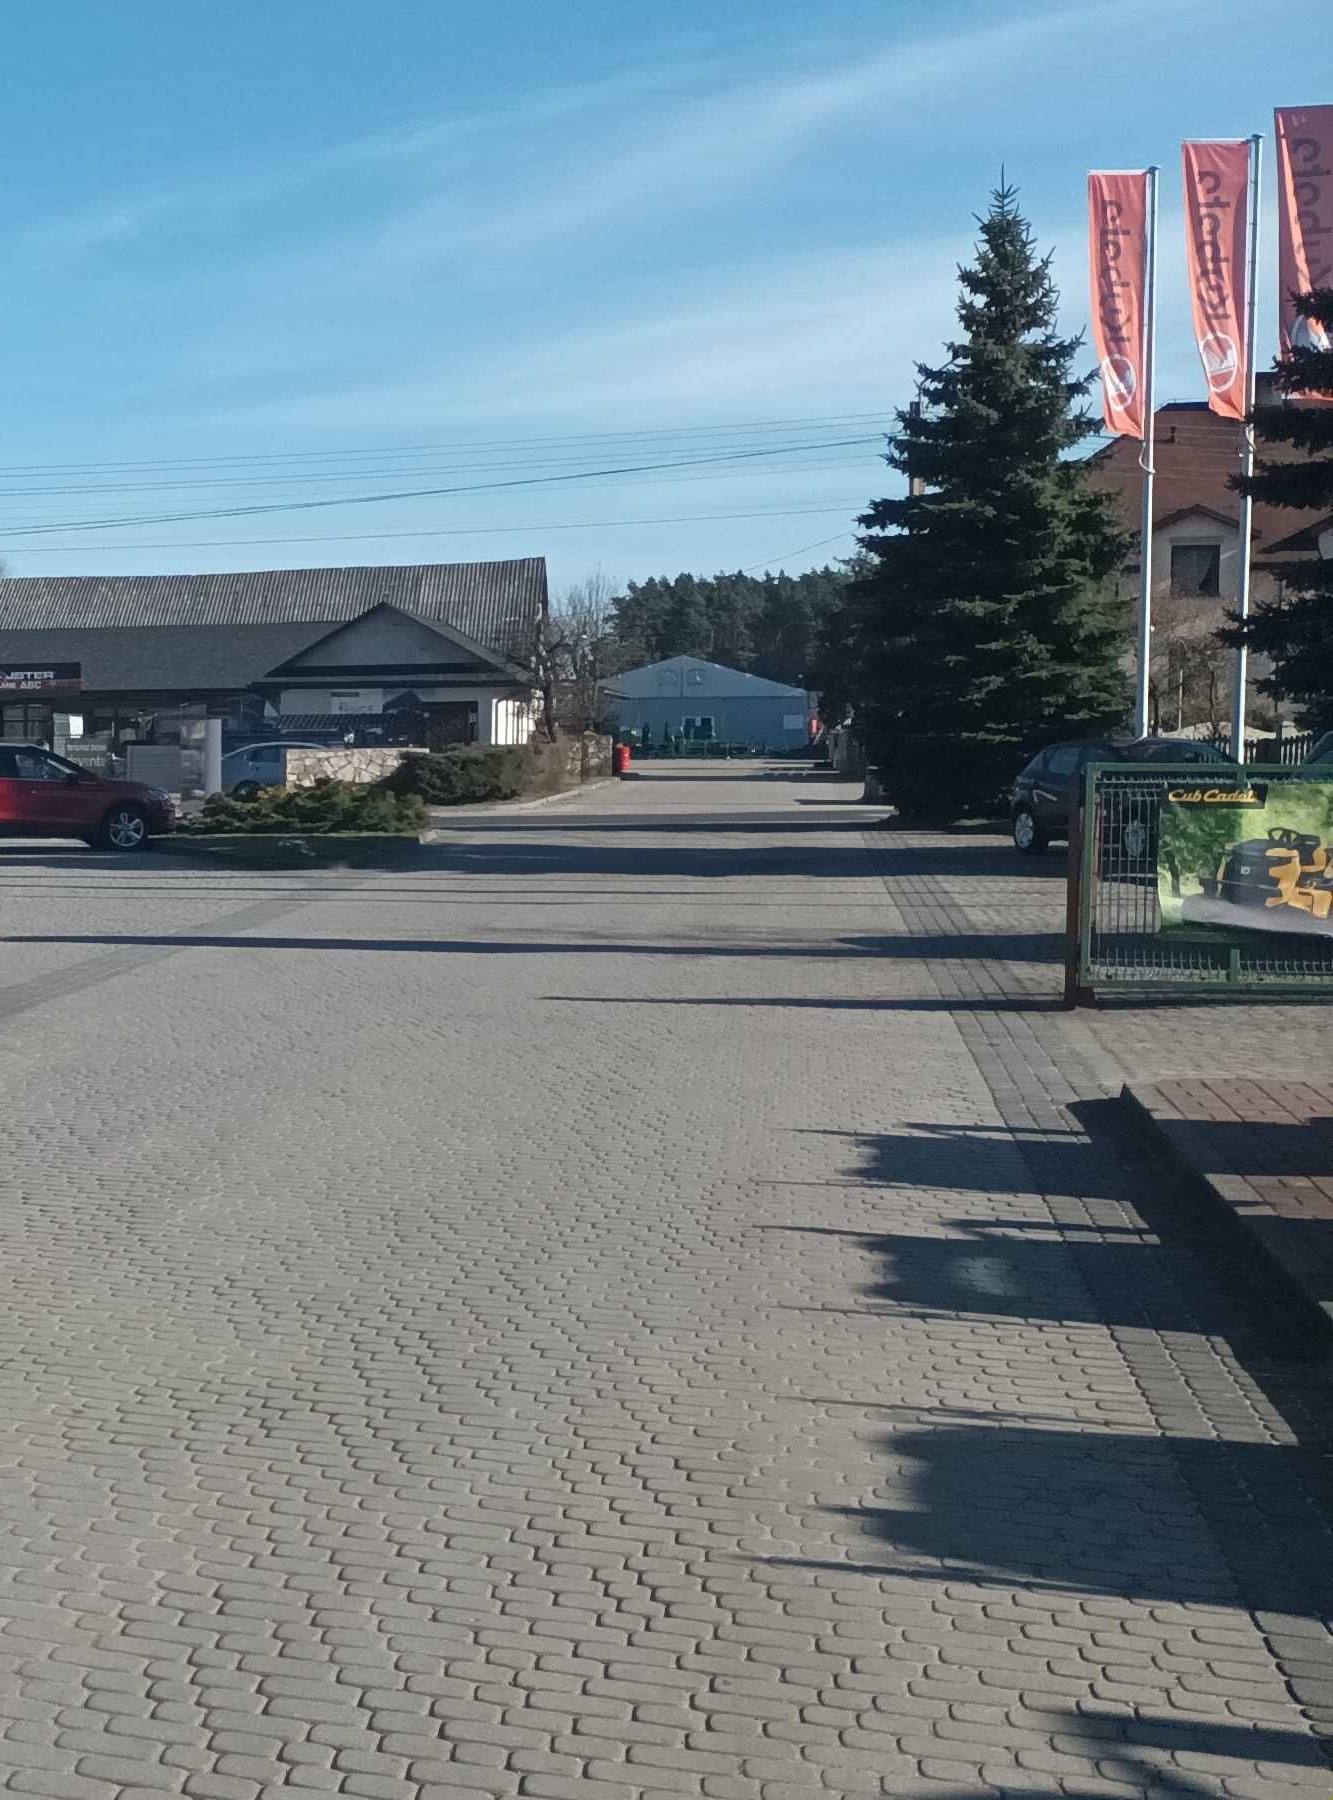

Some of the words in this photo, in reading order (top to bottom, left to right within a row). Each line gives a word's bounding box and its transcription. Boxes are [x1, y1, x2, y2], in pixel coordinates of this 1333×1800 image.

[19, 680, 42, 690] ABC
[1168, 788, 1202, 802] Cub
[1203, 788, 1255, 803] Cadet
